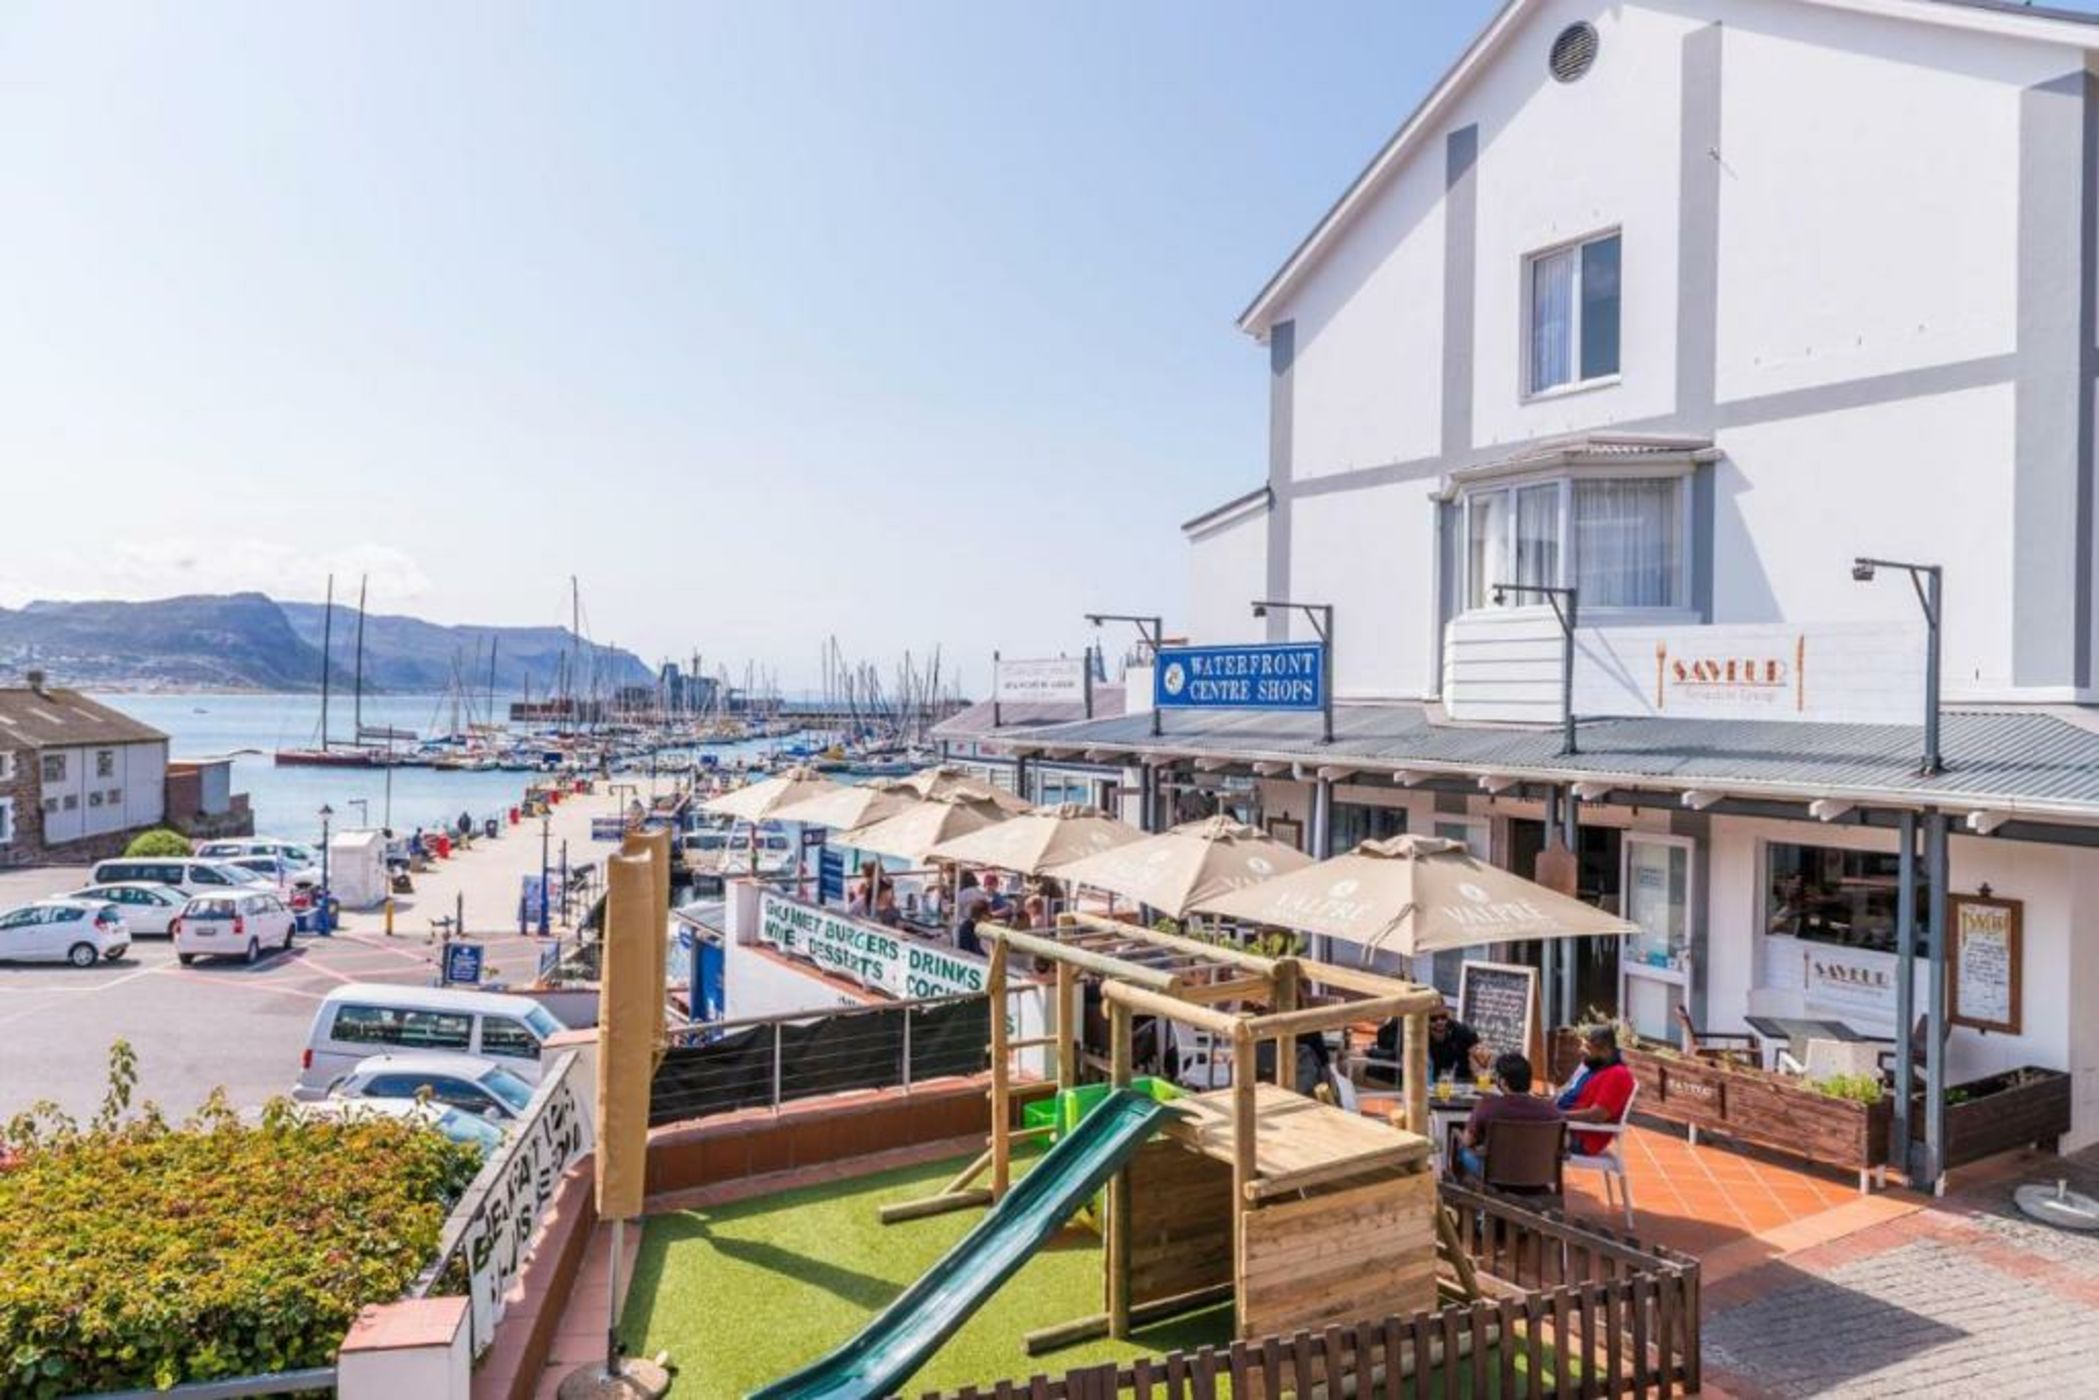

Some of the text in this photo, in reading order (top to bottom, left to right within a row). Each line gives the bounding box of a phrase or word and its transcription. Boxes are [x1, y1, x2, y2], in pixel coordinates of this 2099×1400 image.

[1190, 652, 1315, 677] WATERFRONT
[1189, 679, 1314, 700] CENTRE SHOPS
[825, 920, 899, 960] BURGERS
[909, 949, 981, 991] DRINKS
